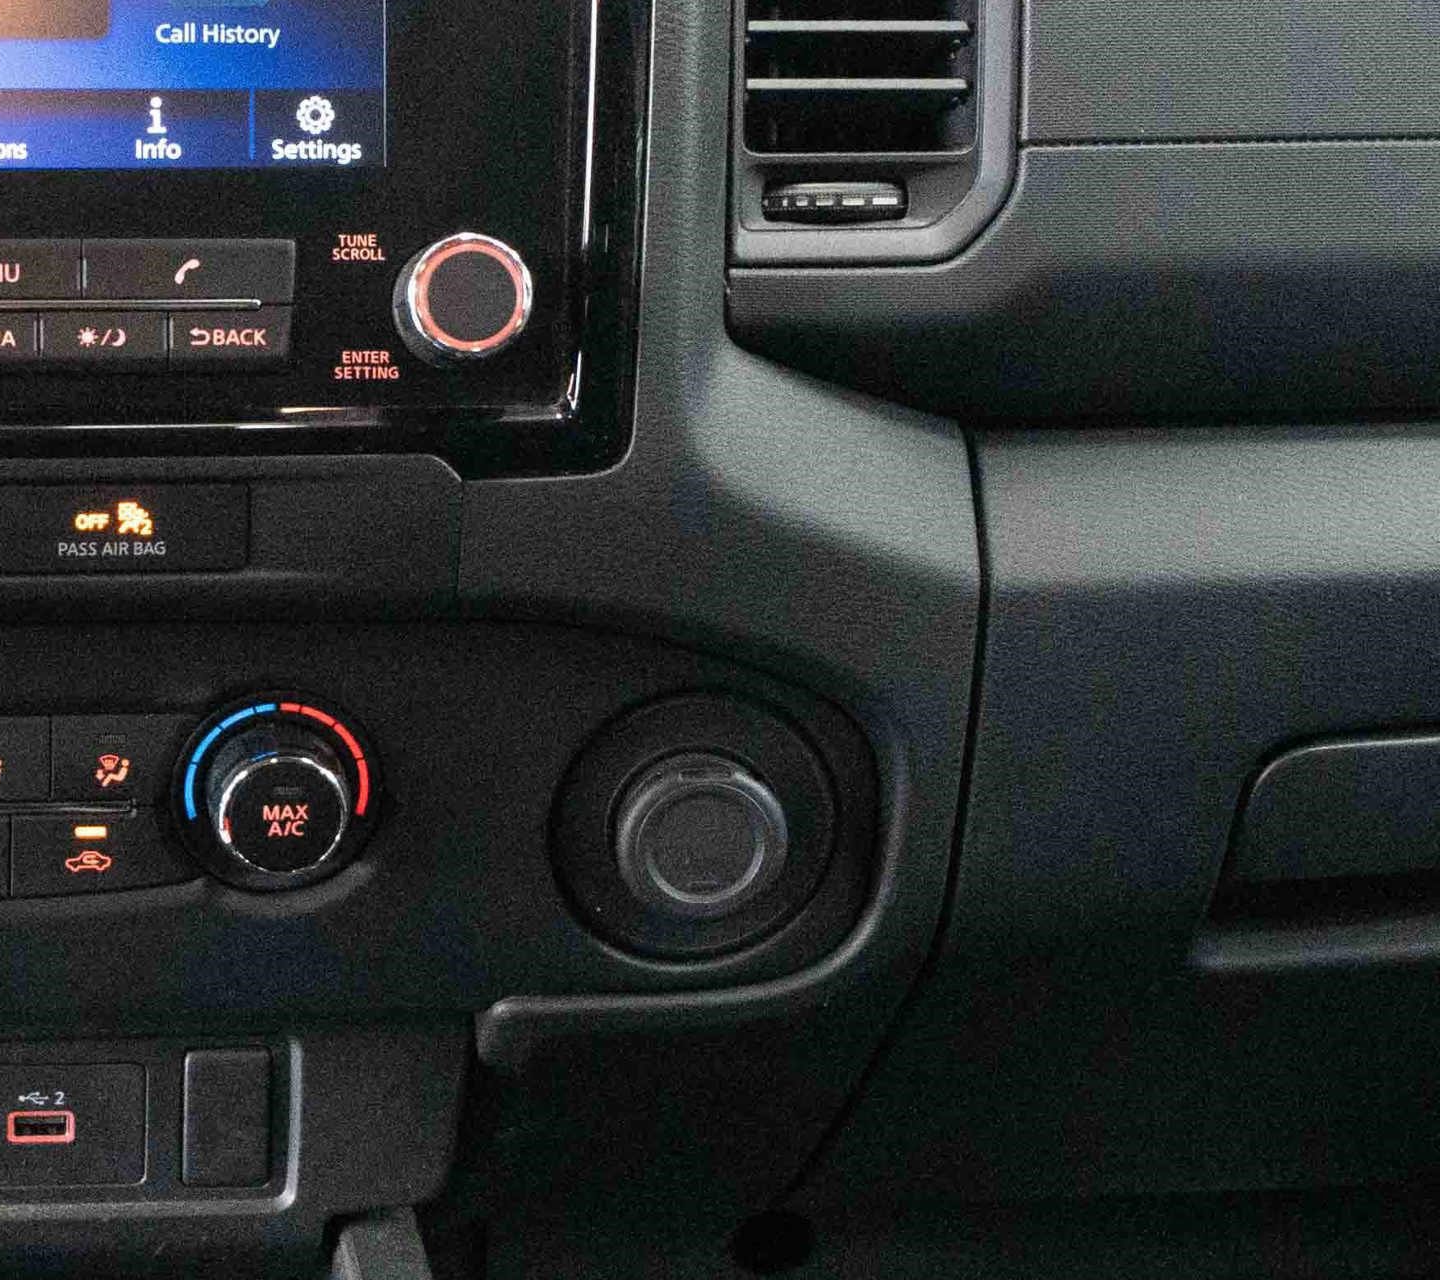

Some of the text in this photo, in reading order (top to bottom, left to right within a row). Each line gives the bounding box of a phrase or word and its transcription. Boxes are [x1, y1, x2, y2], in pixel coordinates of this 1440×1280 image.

[154, 22, 281, 52] Call History
[133, 136, 182, 161] Info
[270, 137, 363, 166] Settings
[337, 234, 377, 248] TUNE
[332, 247, 386, 262] SCROLL
[212, 328, 267, 347] BACK
[342, 351, 389, 365] ENTER
[334, 365, 400, 380] SETTING
[74, 513, 109, 531] OFF
[57, 540, 167, 557] PASS AIR BAG
[262, 804, 308, 822] MAX
[266, 821, 305, 838] A/C
[54, 1091, 65, 1106] 2
